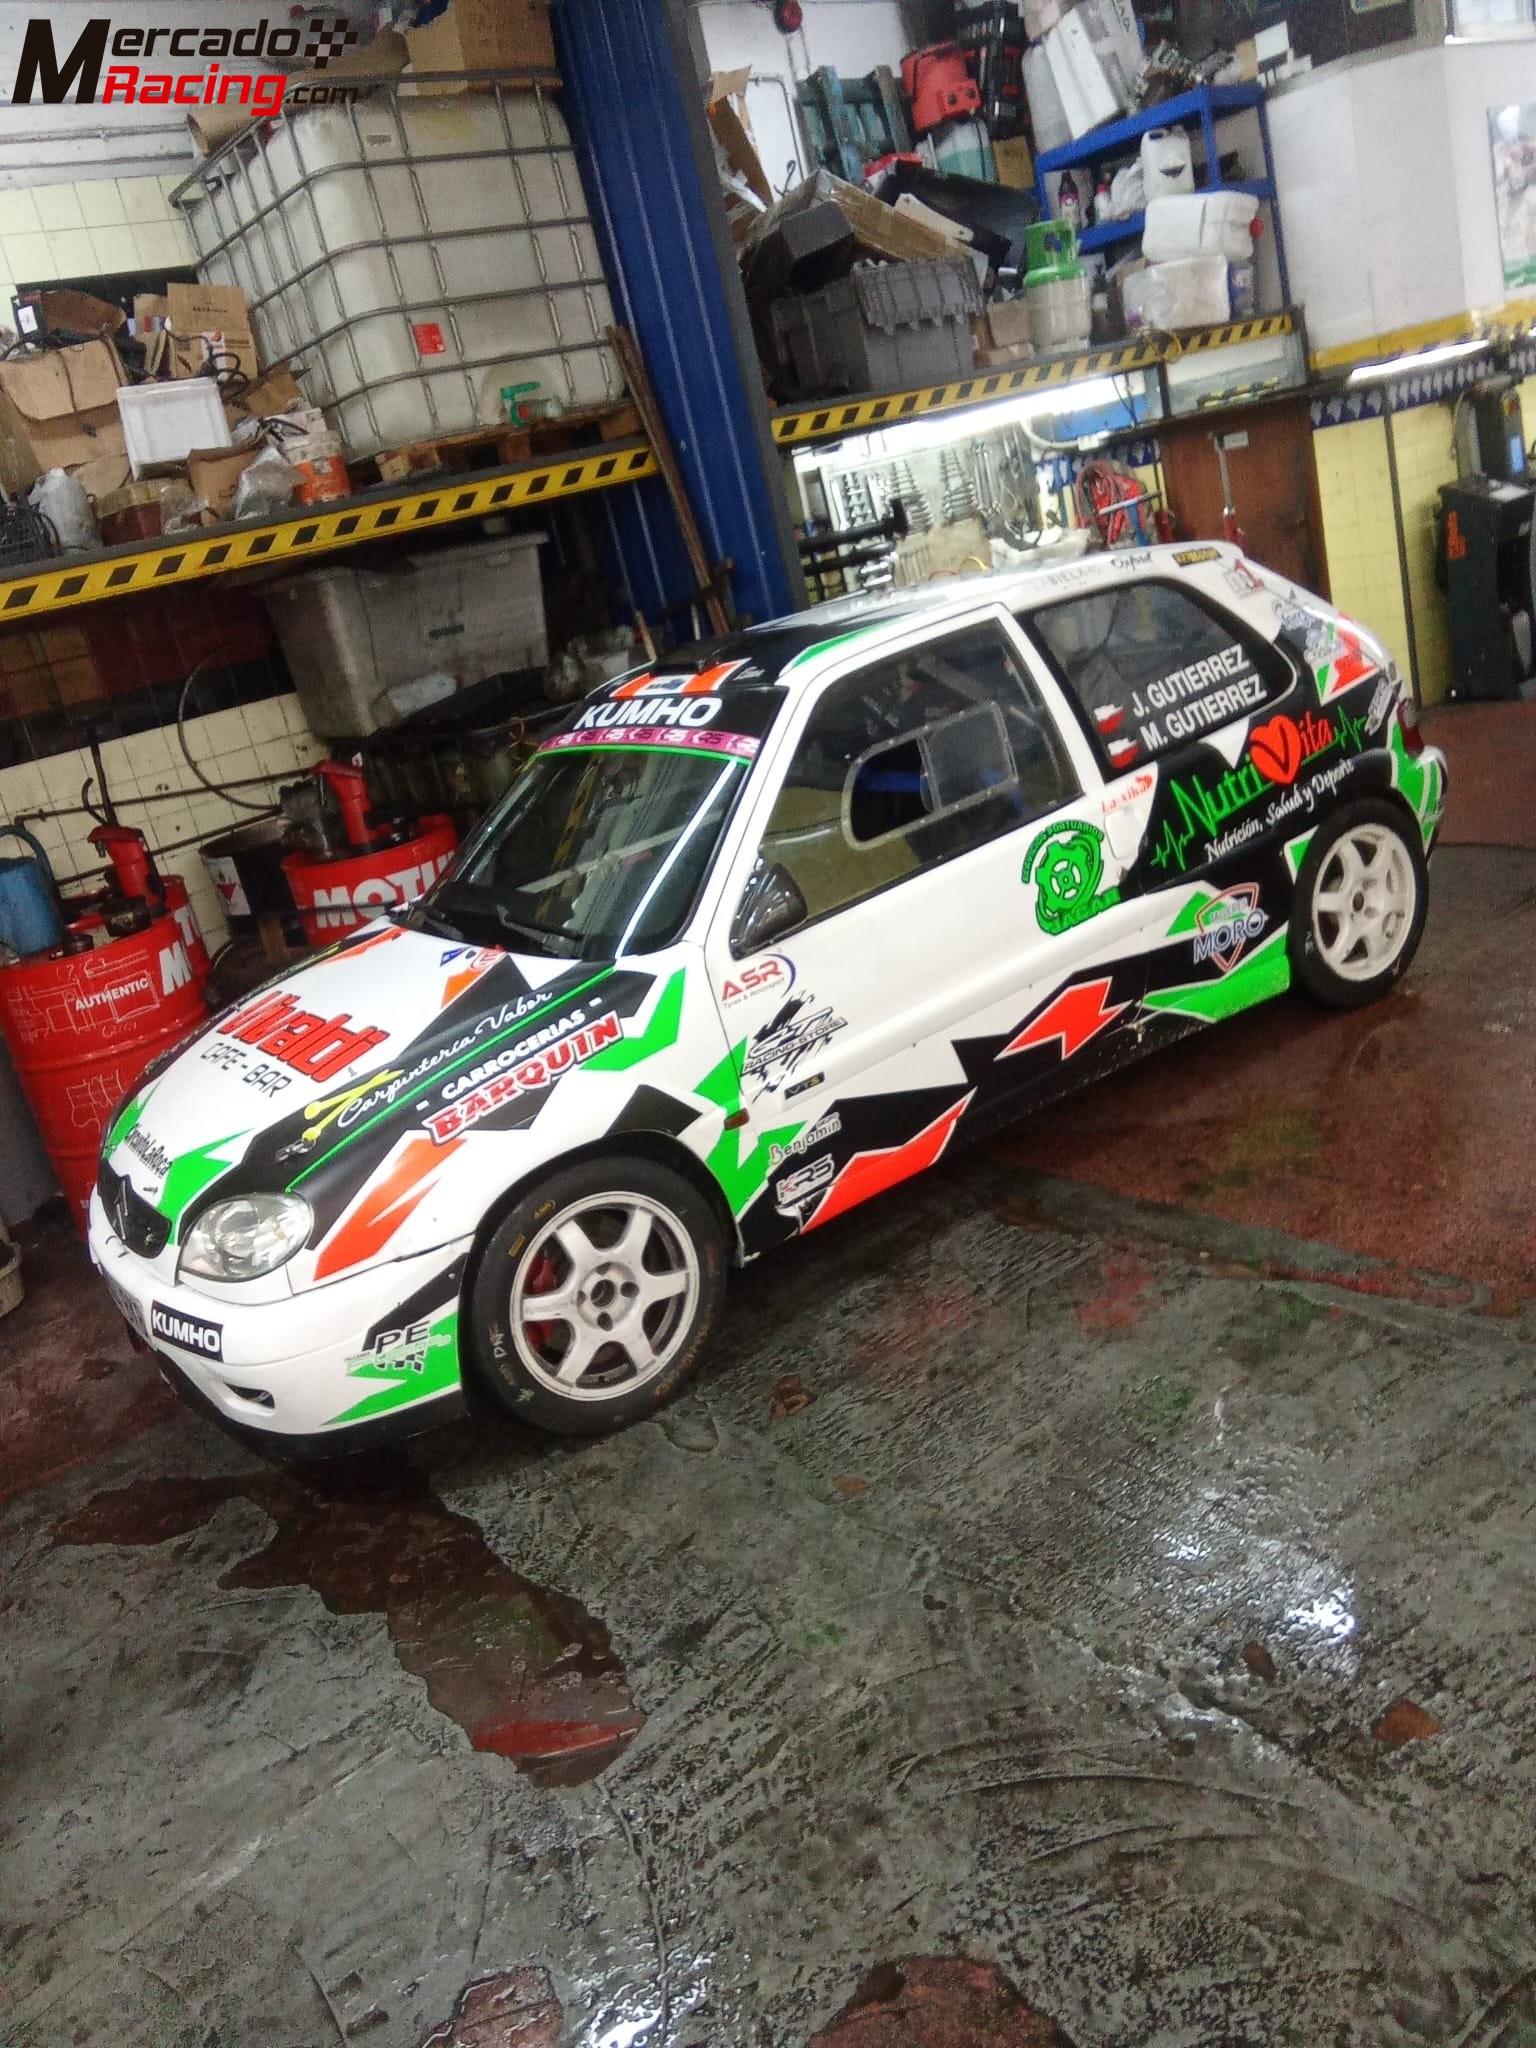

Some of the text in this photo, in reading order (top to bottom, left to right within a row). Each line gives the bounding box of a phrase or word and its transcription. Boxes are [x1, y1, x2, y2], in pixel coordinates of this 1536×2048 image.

[1132, 691, 1149, 718] J.
[1146, 643, 1250, 709] GUTIERREZ
[573, 698, 723, 730] KUMHO
[1140, 673, 1268, 751] M. GUTIERREZ
[1266, 790, 1303, 825] Salud
[1301, 785, 1315, 813] y
[1311, 759, 1355, 796] Deporte
[313, 851, 455, 929] MOTU
[1193, 908, 1266, 965] MORO
[75, 977, 149, 1011] AUTHENTIC
[721, 960, 783, 1001] ASR
[425, 1012, 622, 1142] BARQUIN
[441, 1009, 586, 1101] CARROCERIAS
[770, 1118, 841, 1164] Benjamin
[152, 1308, 220, 1353] KUMHO
